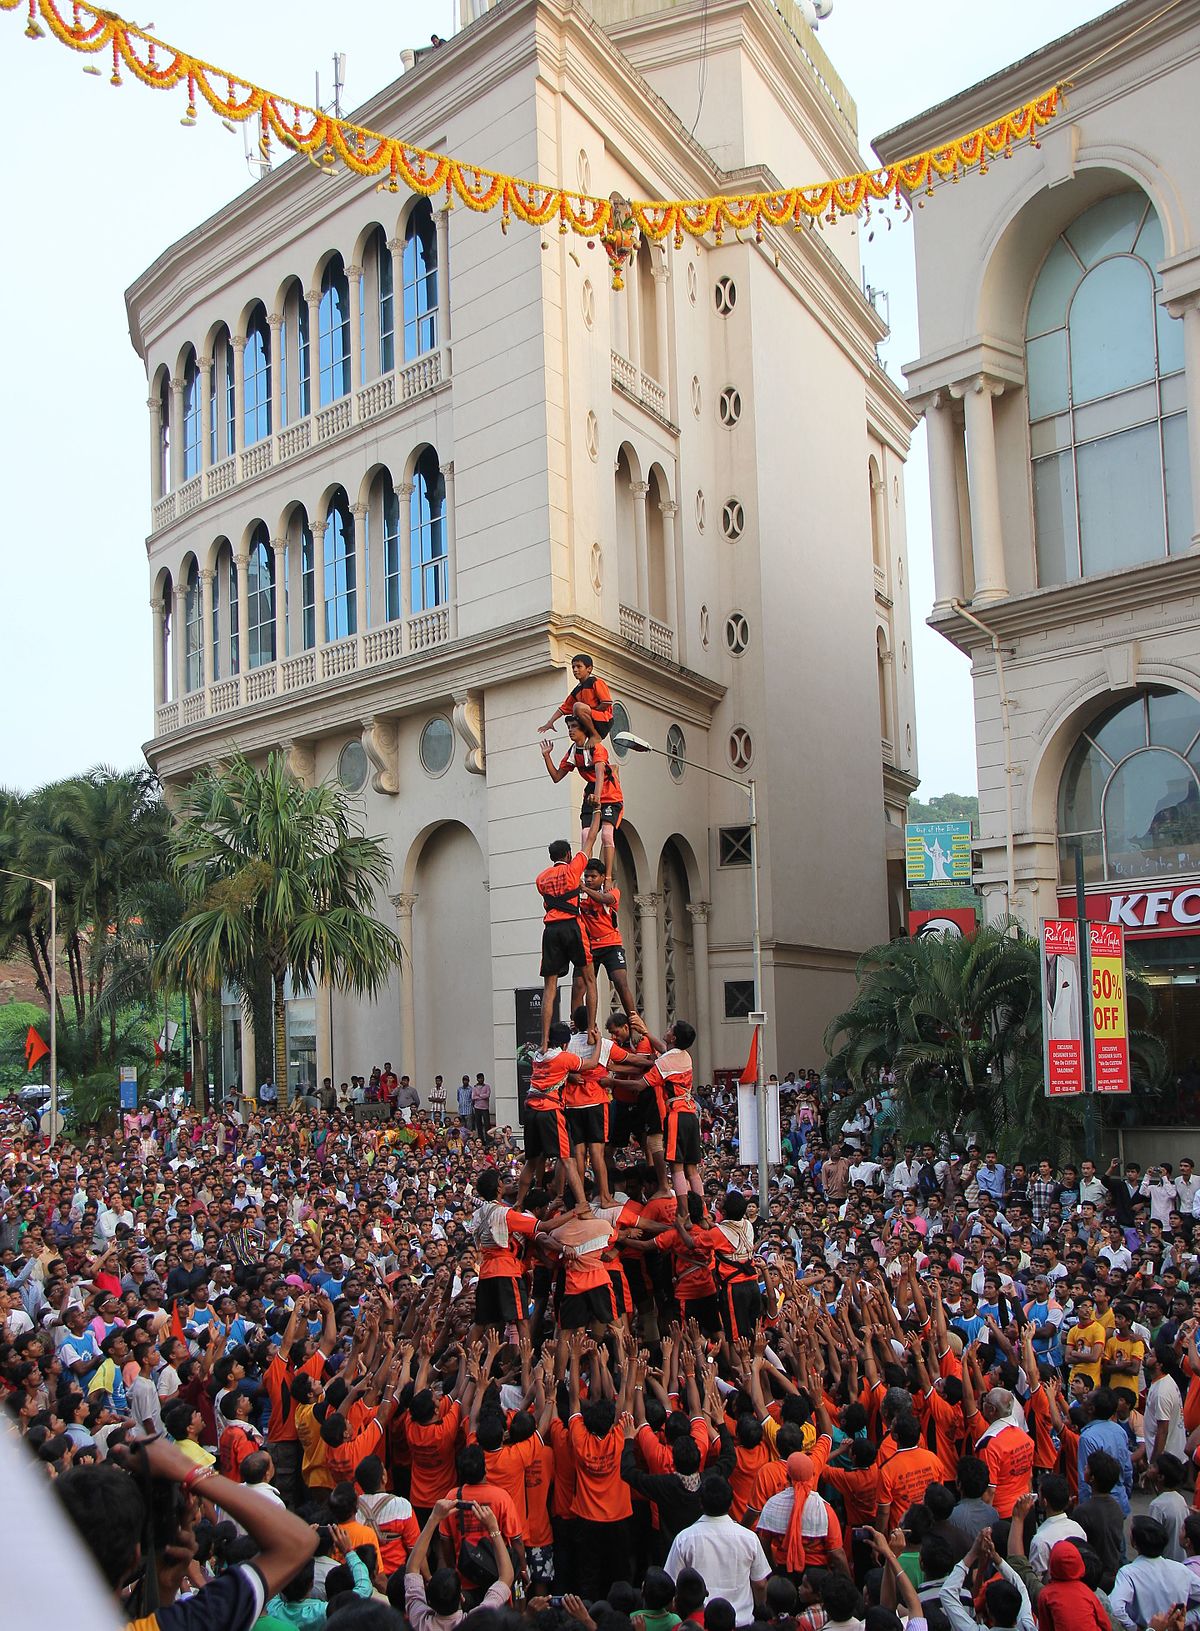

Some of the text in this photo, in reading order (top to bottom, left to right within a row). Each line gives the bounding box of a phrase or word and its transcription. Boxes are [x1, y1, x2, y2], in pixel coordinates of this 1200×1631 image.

[1155, 856, 1173, 872] the
[1109, 887, 1200, 926] KFC
[1044, 927, 1058, 940] Reid
[1062, 928, 1075, 946] Taylor
[1107, 931, 1120, 949] Taylor
[1092, 970, 1121, 1000] 50%
[1094, 1007, 1118, 1030] OFF
